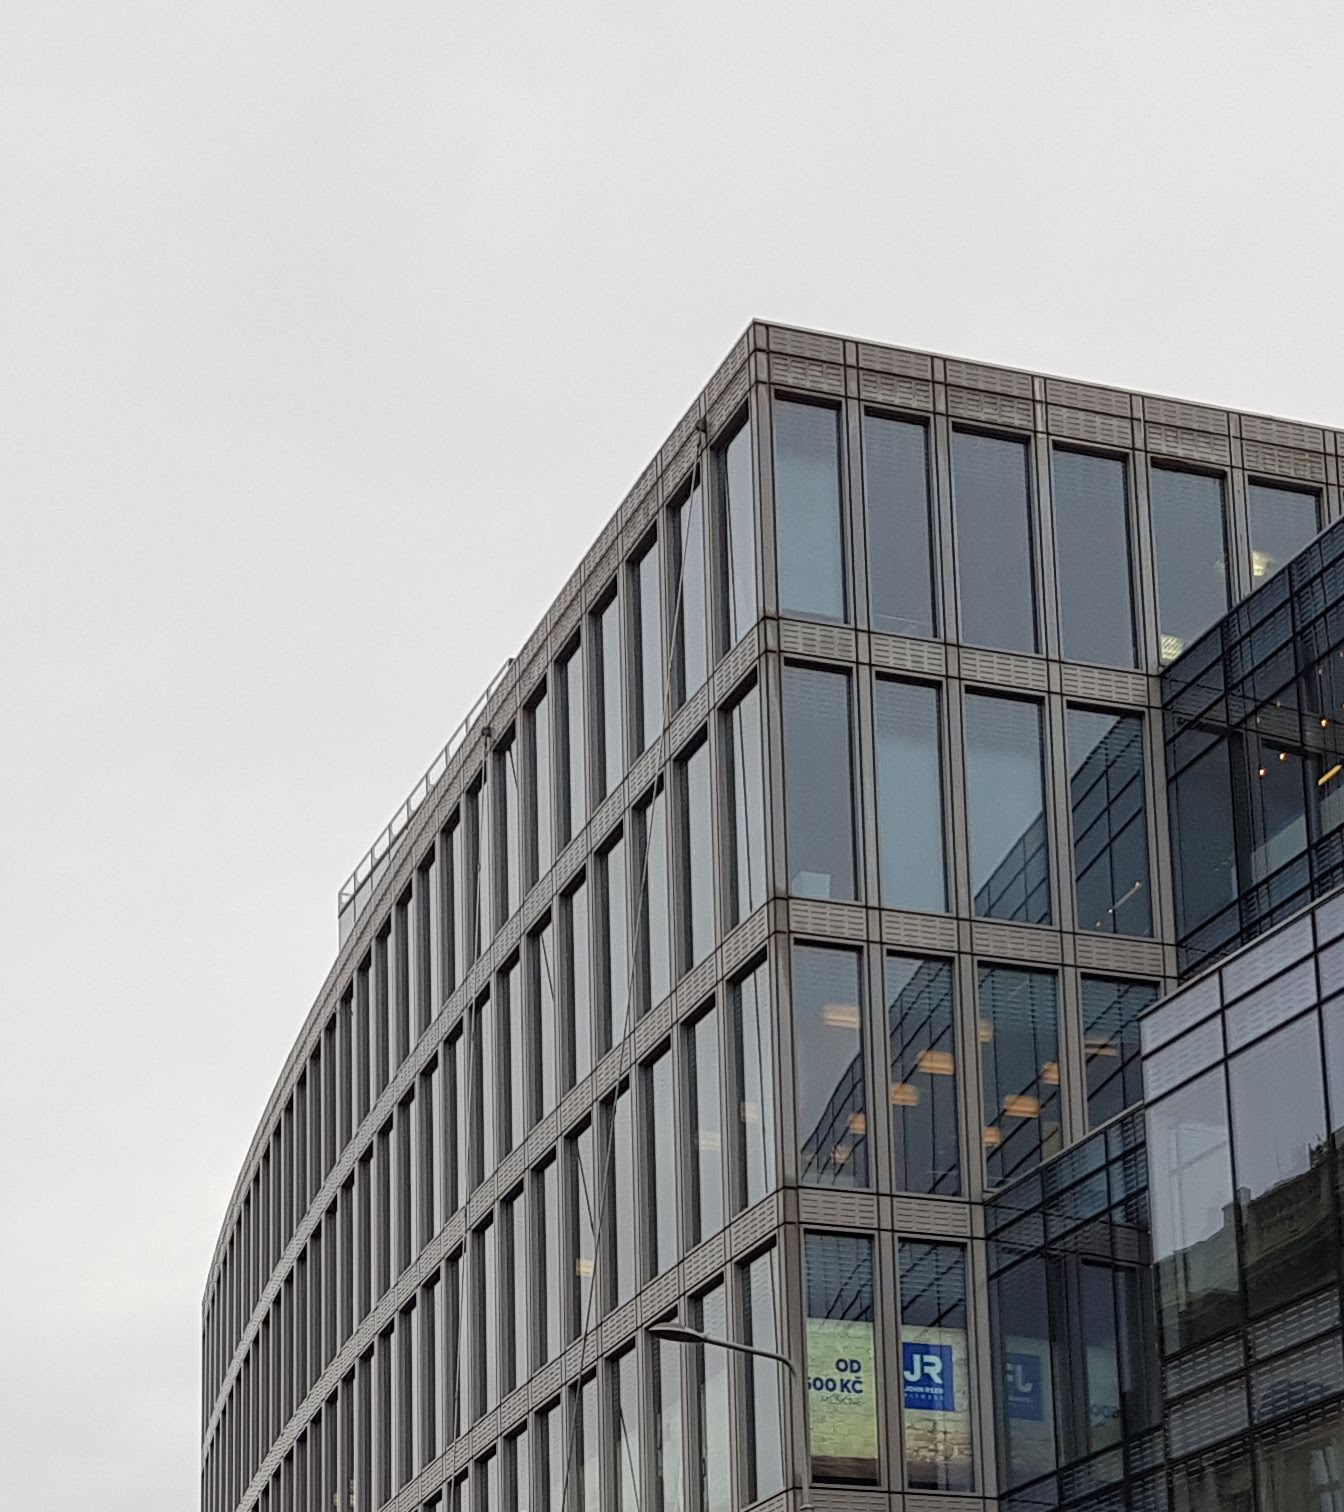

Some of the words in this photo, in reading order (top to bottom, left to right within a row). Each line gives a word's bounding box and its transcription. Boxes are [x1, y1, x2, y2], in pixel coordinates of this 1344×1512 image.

[835, 1358, 862, 1373] OD
[903, 1354, 943, 1385] JR
[839, 1376, 864, 1394] KČ
[925, 1387, 944, 1395] REED
